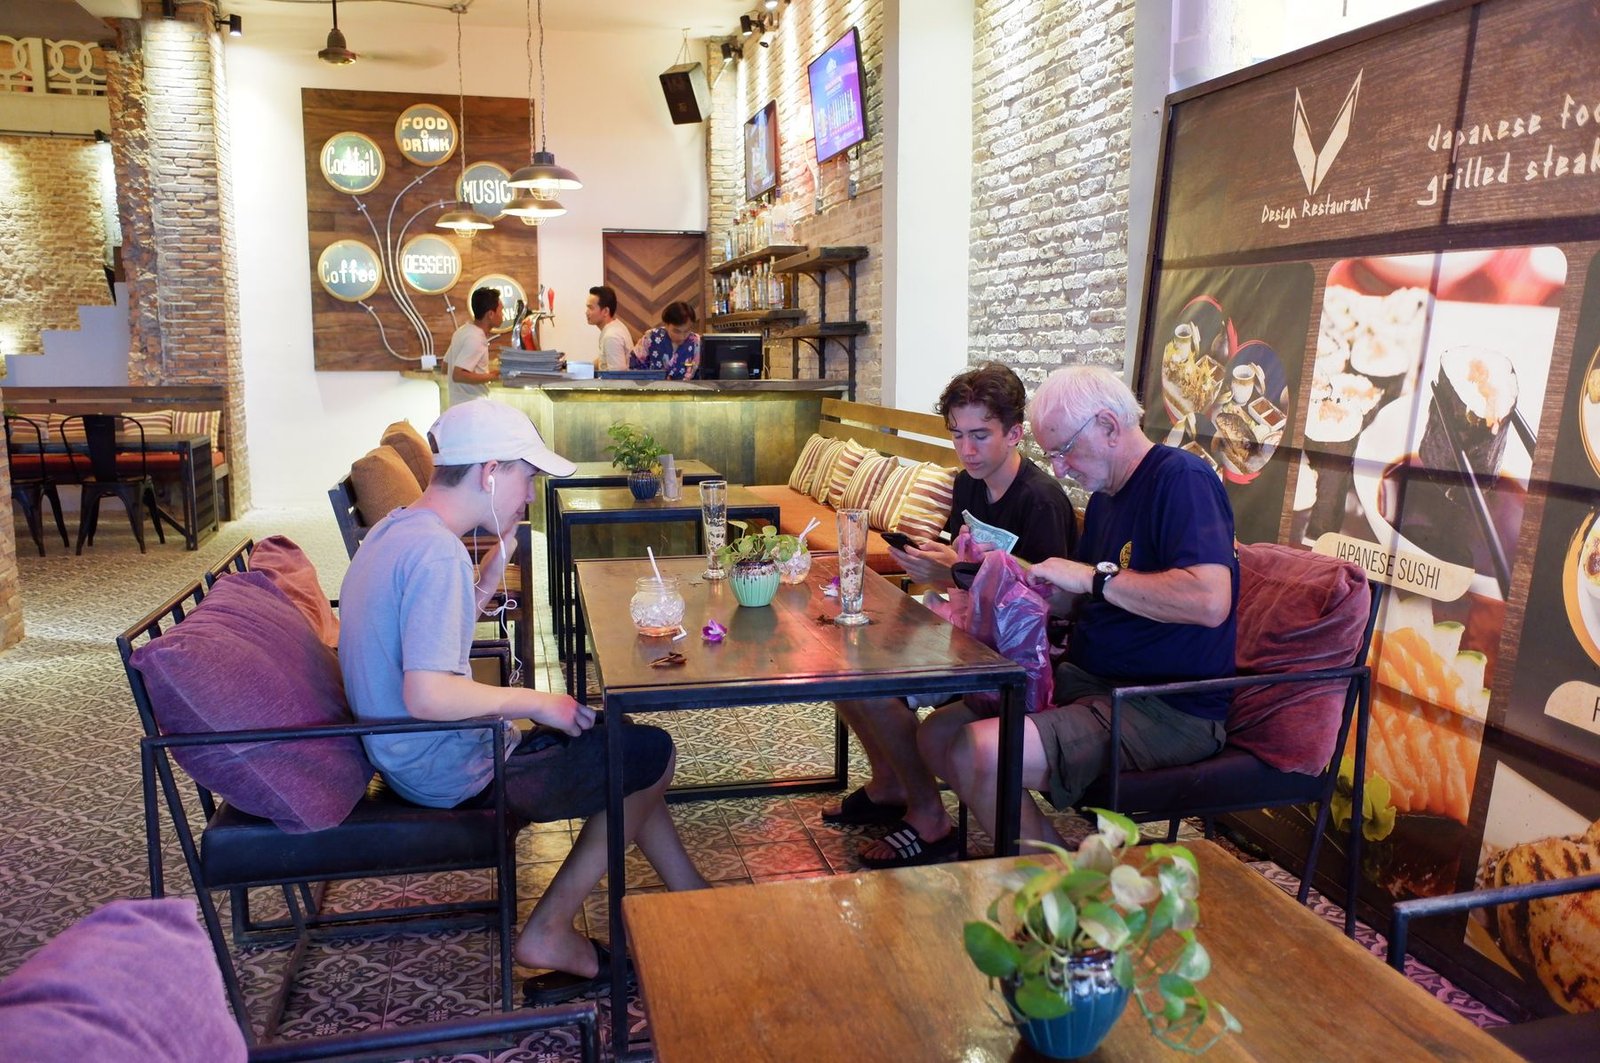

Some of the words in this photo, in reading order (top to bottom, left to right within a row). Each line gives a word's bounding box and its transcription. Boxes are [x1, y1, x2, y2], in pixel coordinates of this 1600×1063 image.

[401, 116, 448, 131] FOOD
[402, 137, 450, 153] DRINK
[326, 146, 378, 178] Cocktail
[462, 178, 513, 205] MUSIC
[1416, 152, 1511, 206] grilled
[1260, 204, 1297, 229] Design
[1301, 187, 1371, 219] Restaurant
[322, 258, 377, 284] Coffee
[404, 254, 457, 275] DESSERT
[1336, 541, 1396, 577] JAPANESE
[1397, 557, 1441, 590] SUSHI
